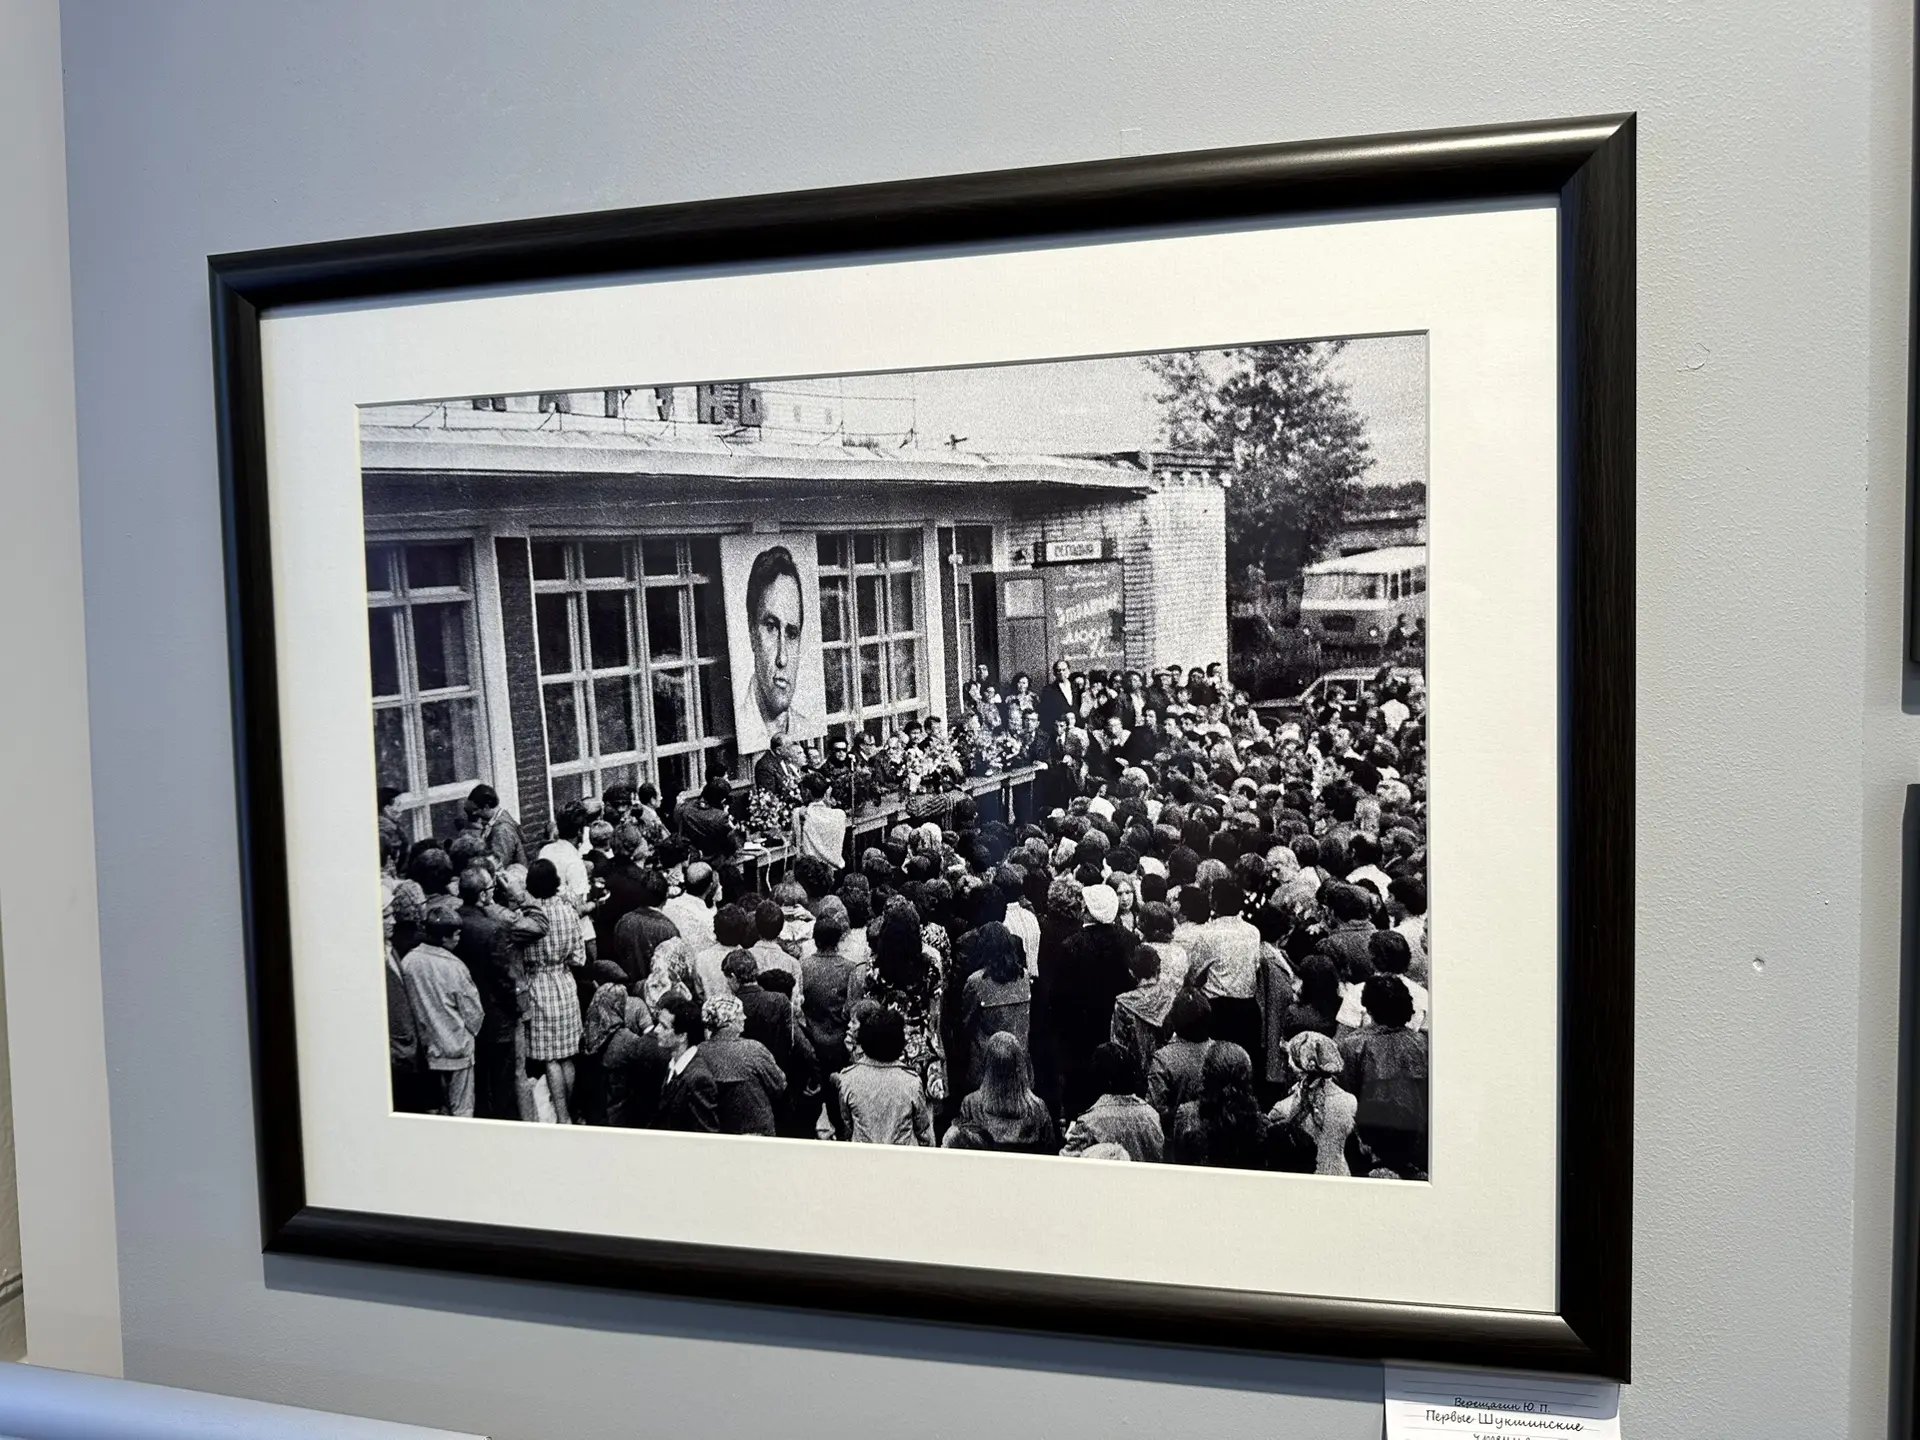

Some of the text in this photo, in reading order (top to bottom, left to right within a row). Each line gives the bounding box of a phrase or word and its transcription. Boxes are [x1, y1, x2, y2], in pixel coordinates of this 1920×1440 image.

[472, 382, 766, 428] ТУНЬ
[1454, 1397, 1551, 1413] Верещагин Ю. П.
[1425, 1409, 1584, 1432] Первые Шукшинские
